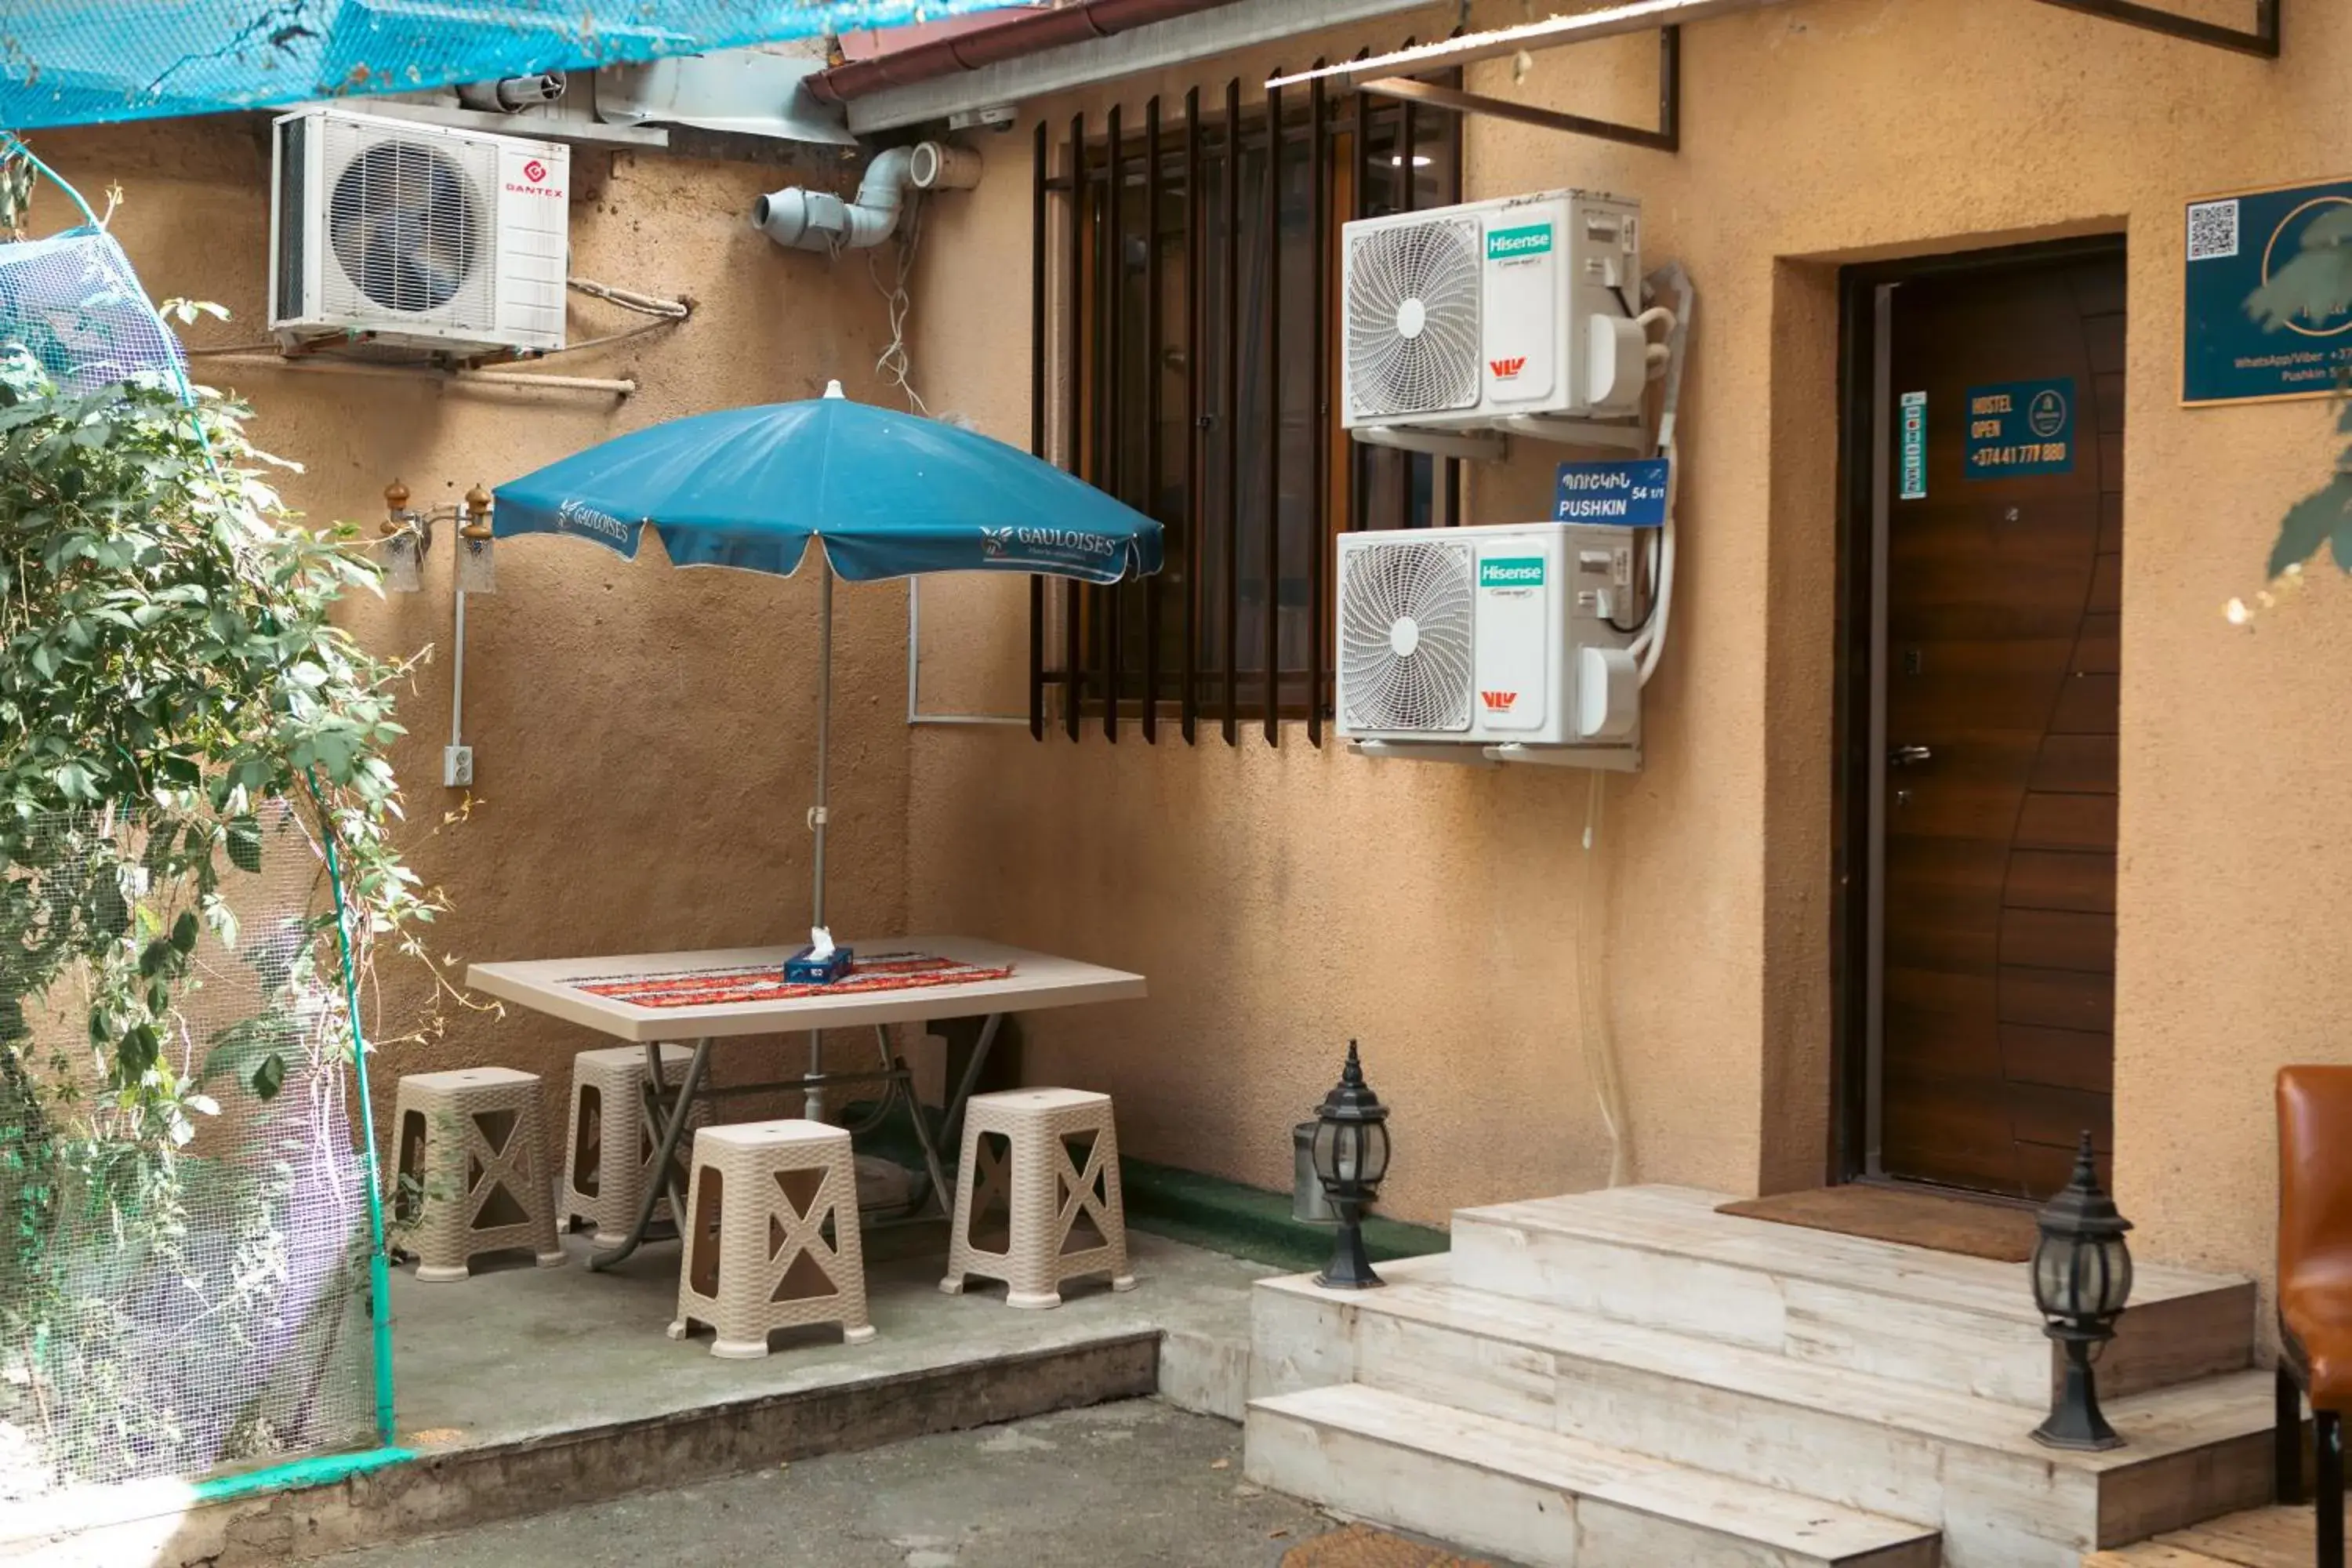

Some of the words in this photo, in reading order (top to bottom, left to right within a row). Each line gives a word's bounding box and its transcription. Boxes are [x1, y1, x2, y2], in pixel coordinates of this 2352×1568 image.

[506, 183, 563, 198] DANTEX
[1490, 234, 1549, 252] Hisense
[1972, 394, 2013, 415] HOSTEL
[1971, 419, 2001, 439] OPEN
[1632, 486, 1647, 499] 54
[1559, 499, 1627, 517] PUSHKIN
[574, 506, 628, 543] GAULOISES
[1018, 527, 1116, 557] GAULOISES
[1483, 565, 1541, 580] Hisense
